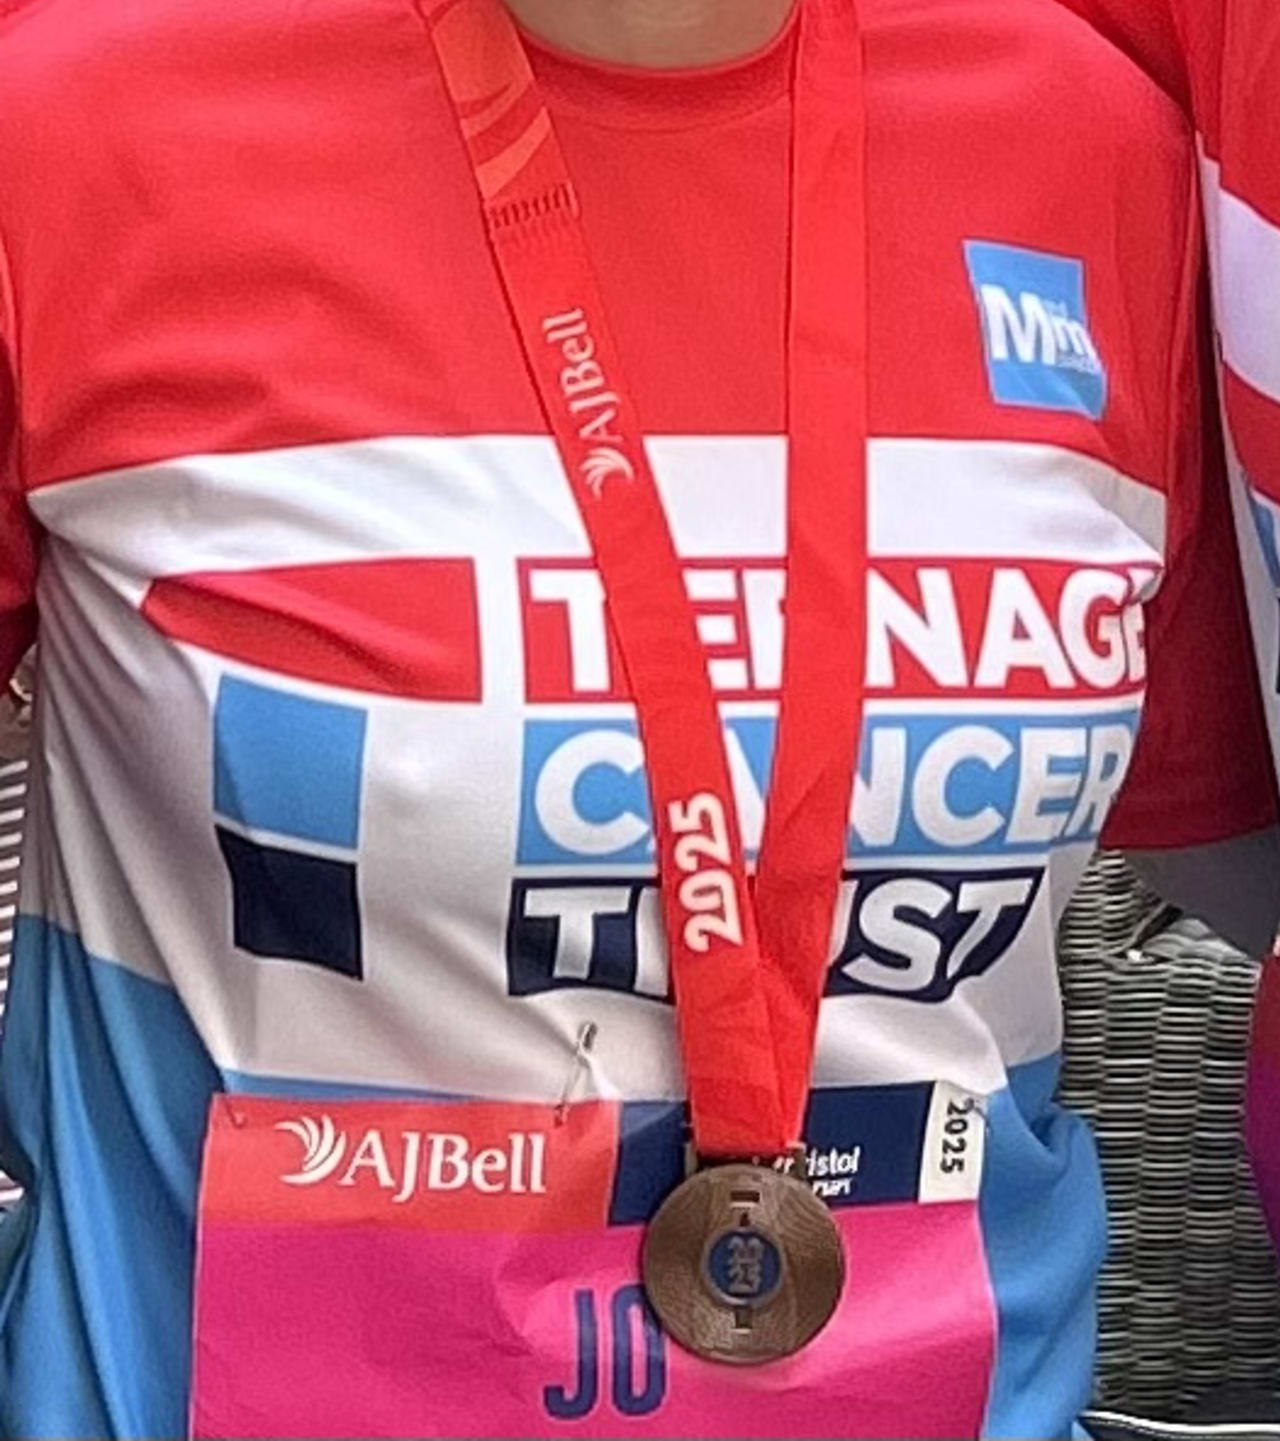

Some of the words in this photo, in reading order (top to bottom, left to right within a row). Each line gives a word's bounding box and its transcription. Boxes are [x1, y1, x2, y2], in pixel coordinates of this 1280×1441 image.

[543, 308, 621, 442] AJBell
[667, 793, 744, 952] 2025
[522, 878, 1035, 994] TST
[340, 1129, 547, 1203] AJBell
[940, 1098, 974, 1174] 2025
[543, 1284, 666, 1421] JO
